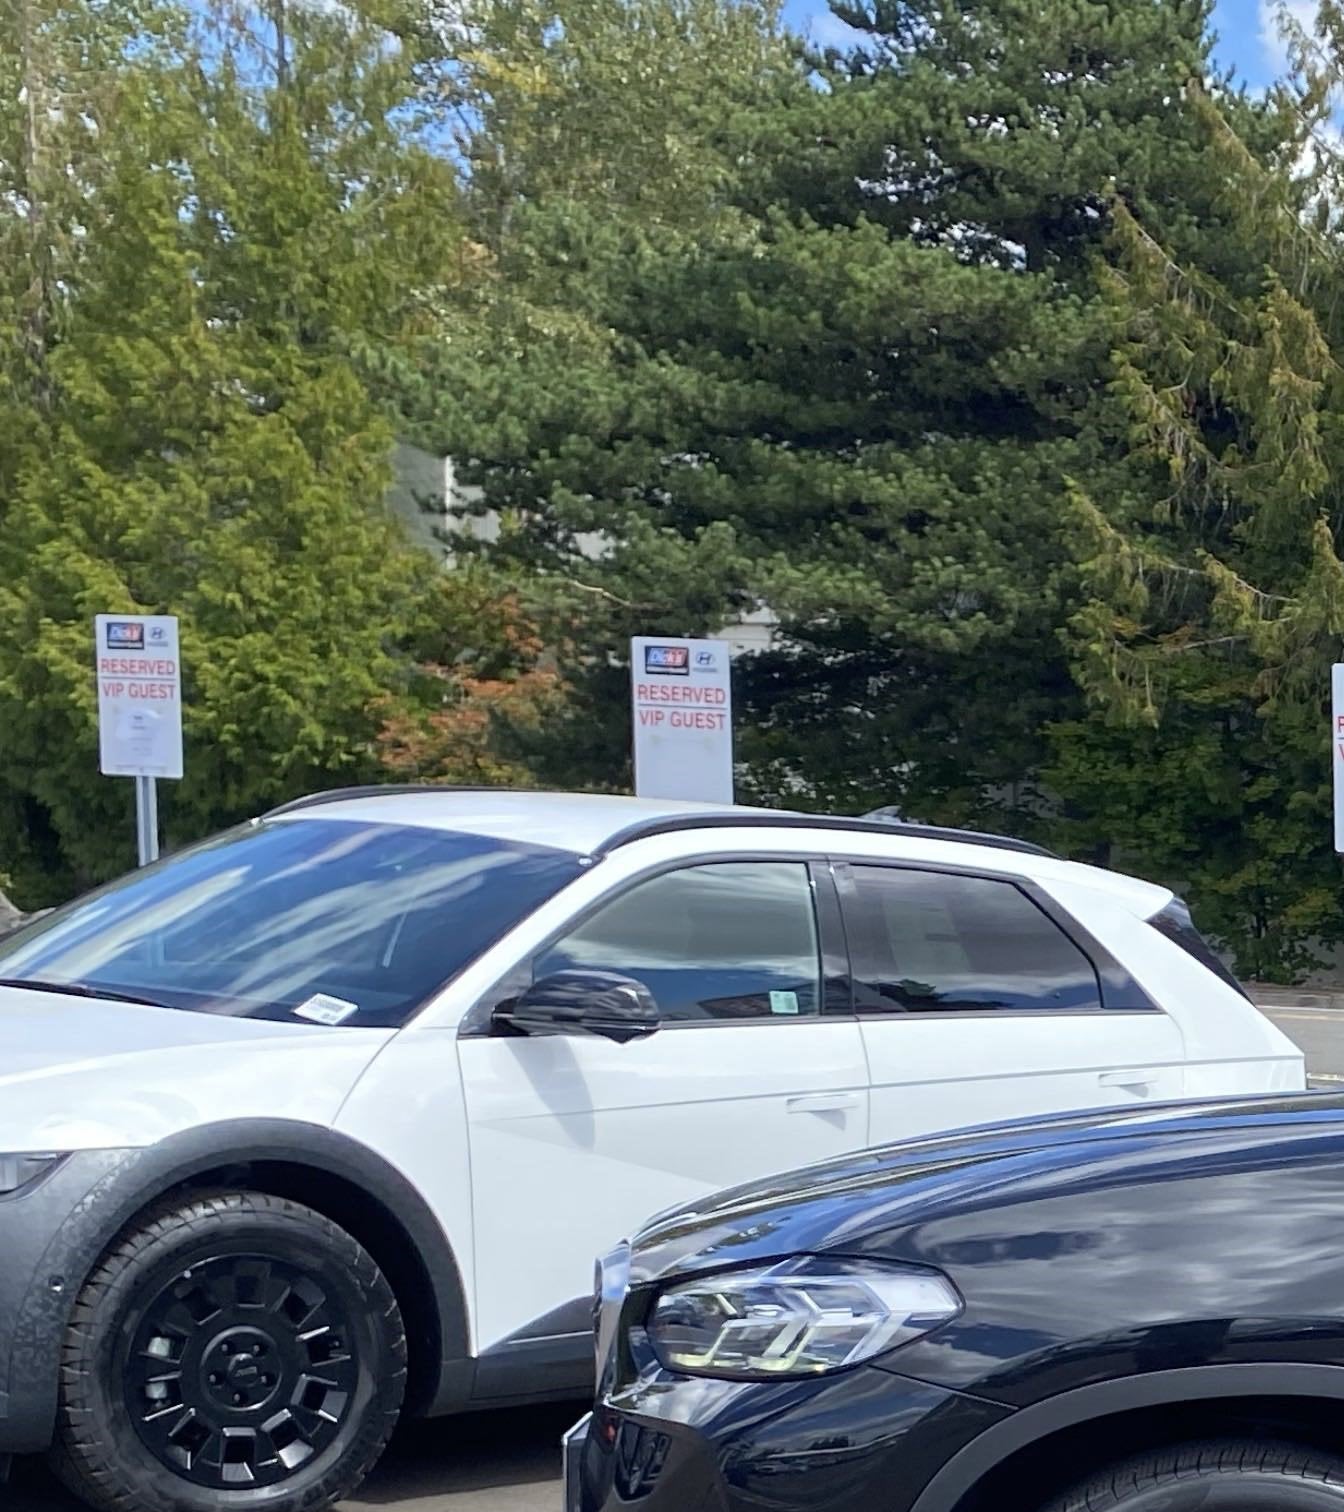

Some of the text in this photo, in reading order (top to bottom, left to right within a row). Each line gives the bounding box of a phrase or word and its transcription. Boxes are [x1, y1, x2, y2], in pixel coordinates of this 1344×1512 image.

[101, 659, 176, 676] RESERVED
[103, 682, 176, 700] VIP GUEST
[638, 685, 726, 705] RESERVED
[639, 710, 727, 730] VIP GUEST
